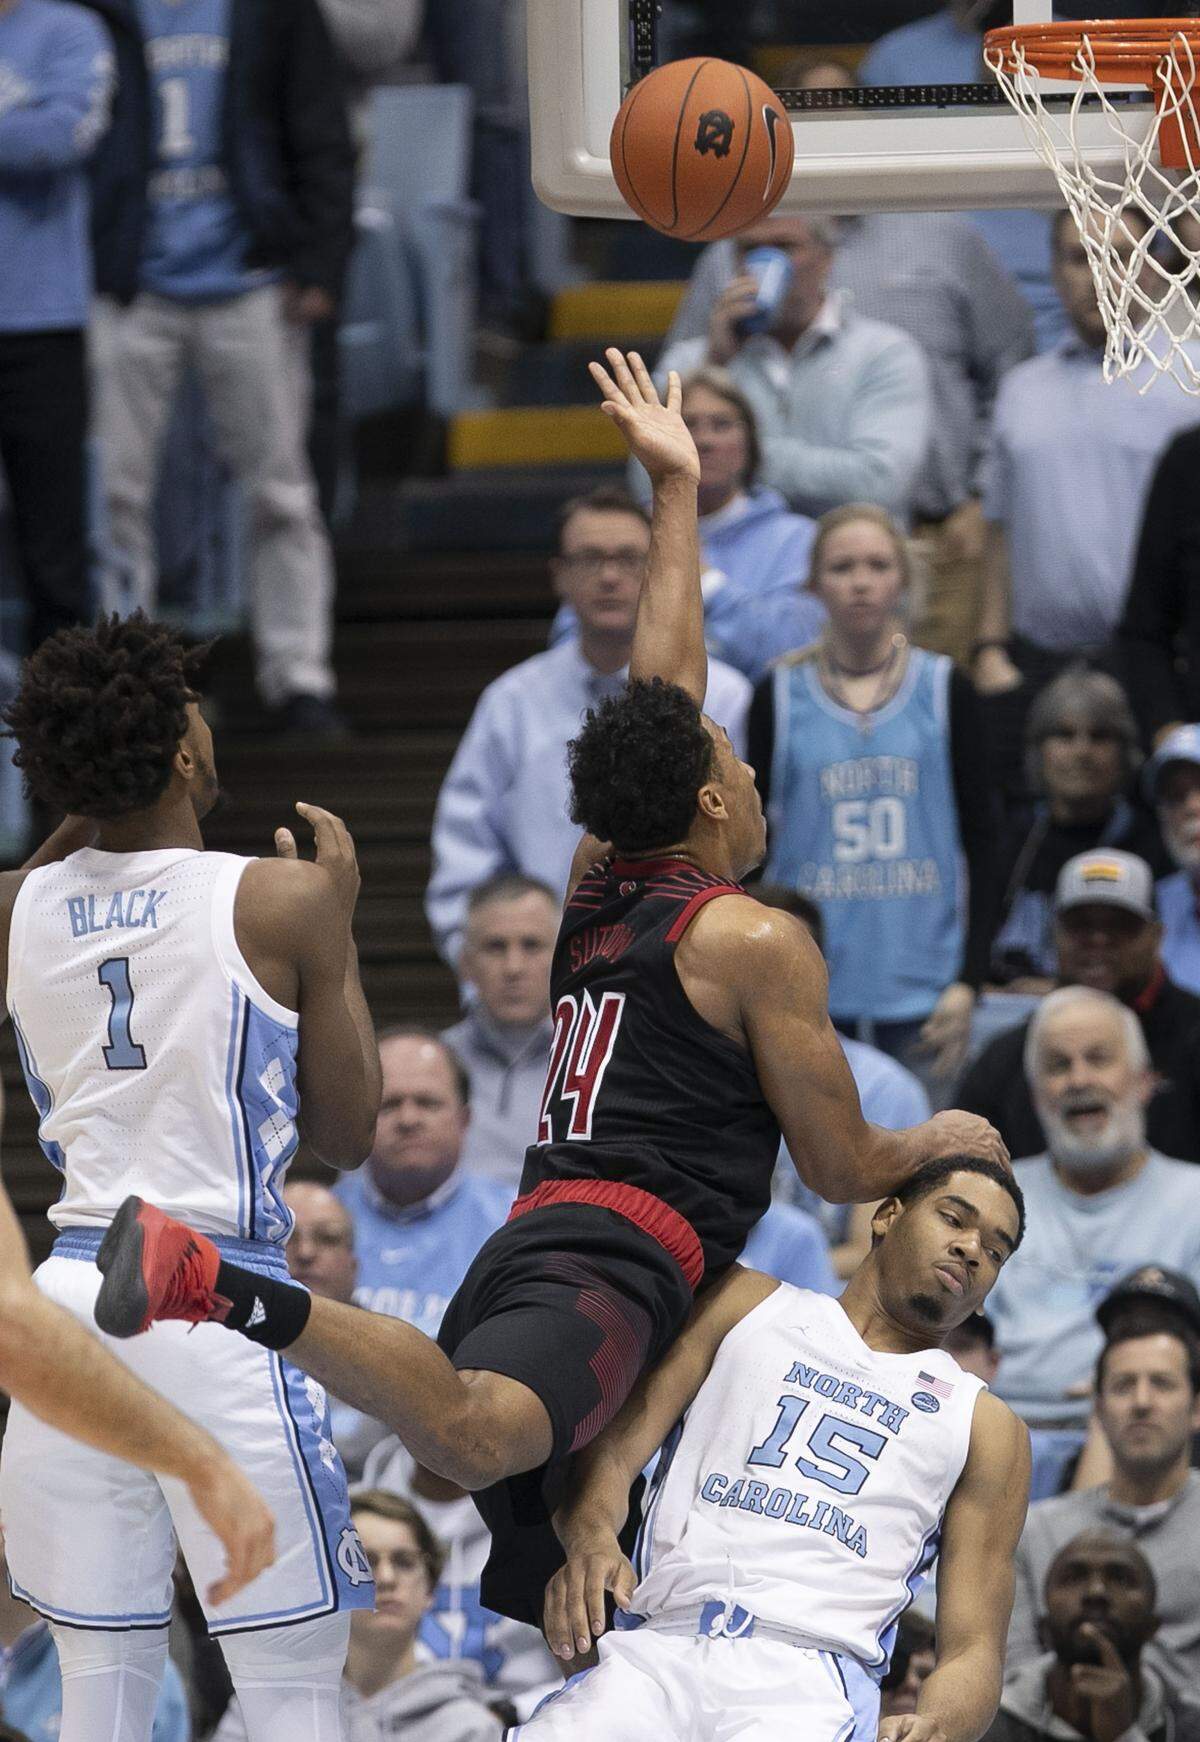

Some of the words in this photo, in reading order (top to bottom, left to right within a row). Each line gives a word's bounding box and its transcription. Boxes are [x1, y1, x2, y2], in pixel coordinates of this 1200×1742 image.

[833, 797, 906, 863] 50
[66, 889, 168, 938] BLACK
[97, 956, 148, 1070] 1
[537, 987, 626, 1146] 24
[783, 1360, 910, 1435] NORTH
[746, 1394, 889, 1495] 15
[701, 1472, 868, 1559] CAROLINA
